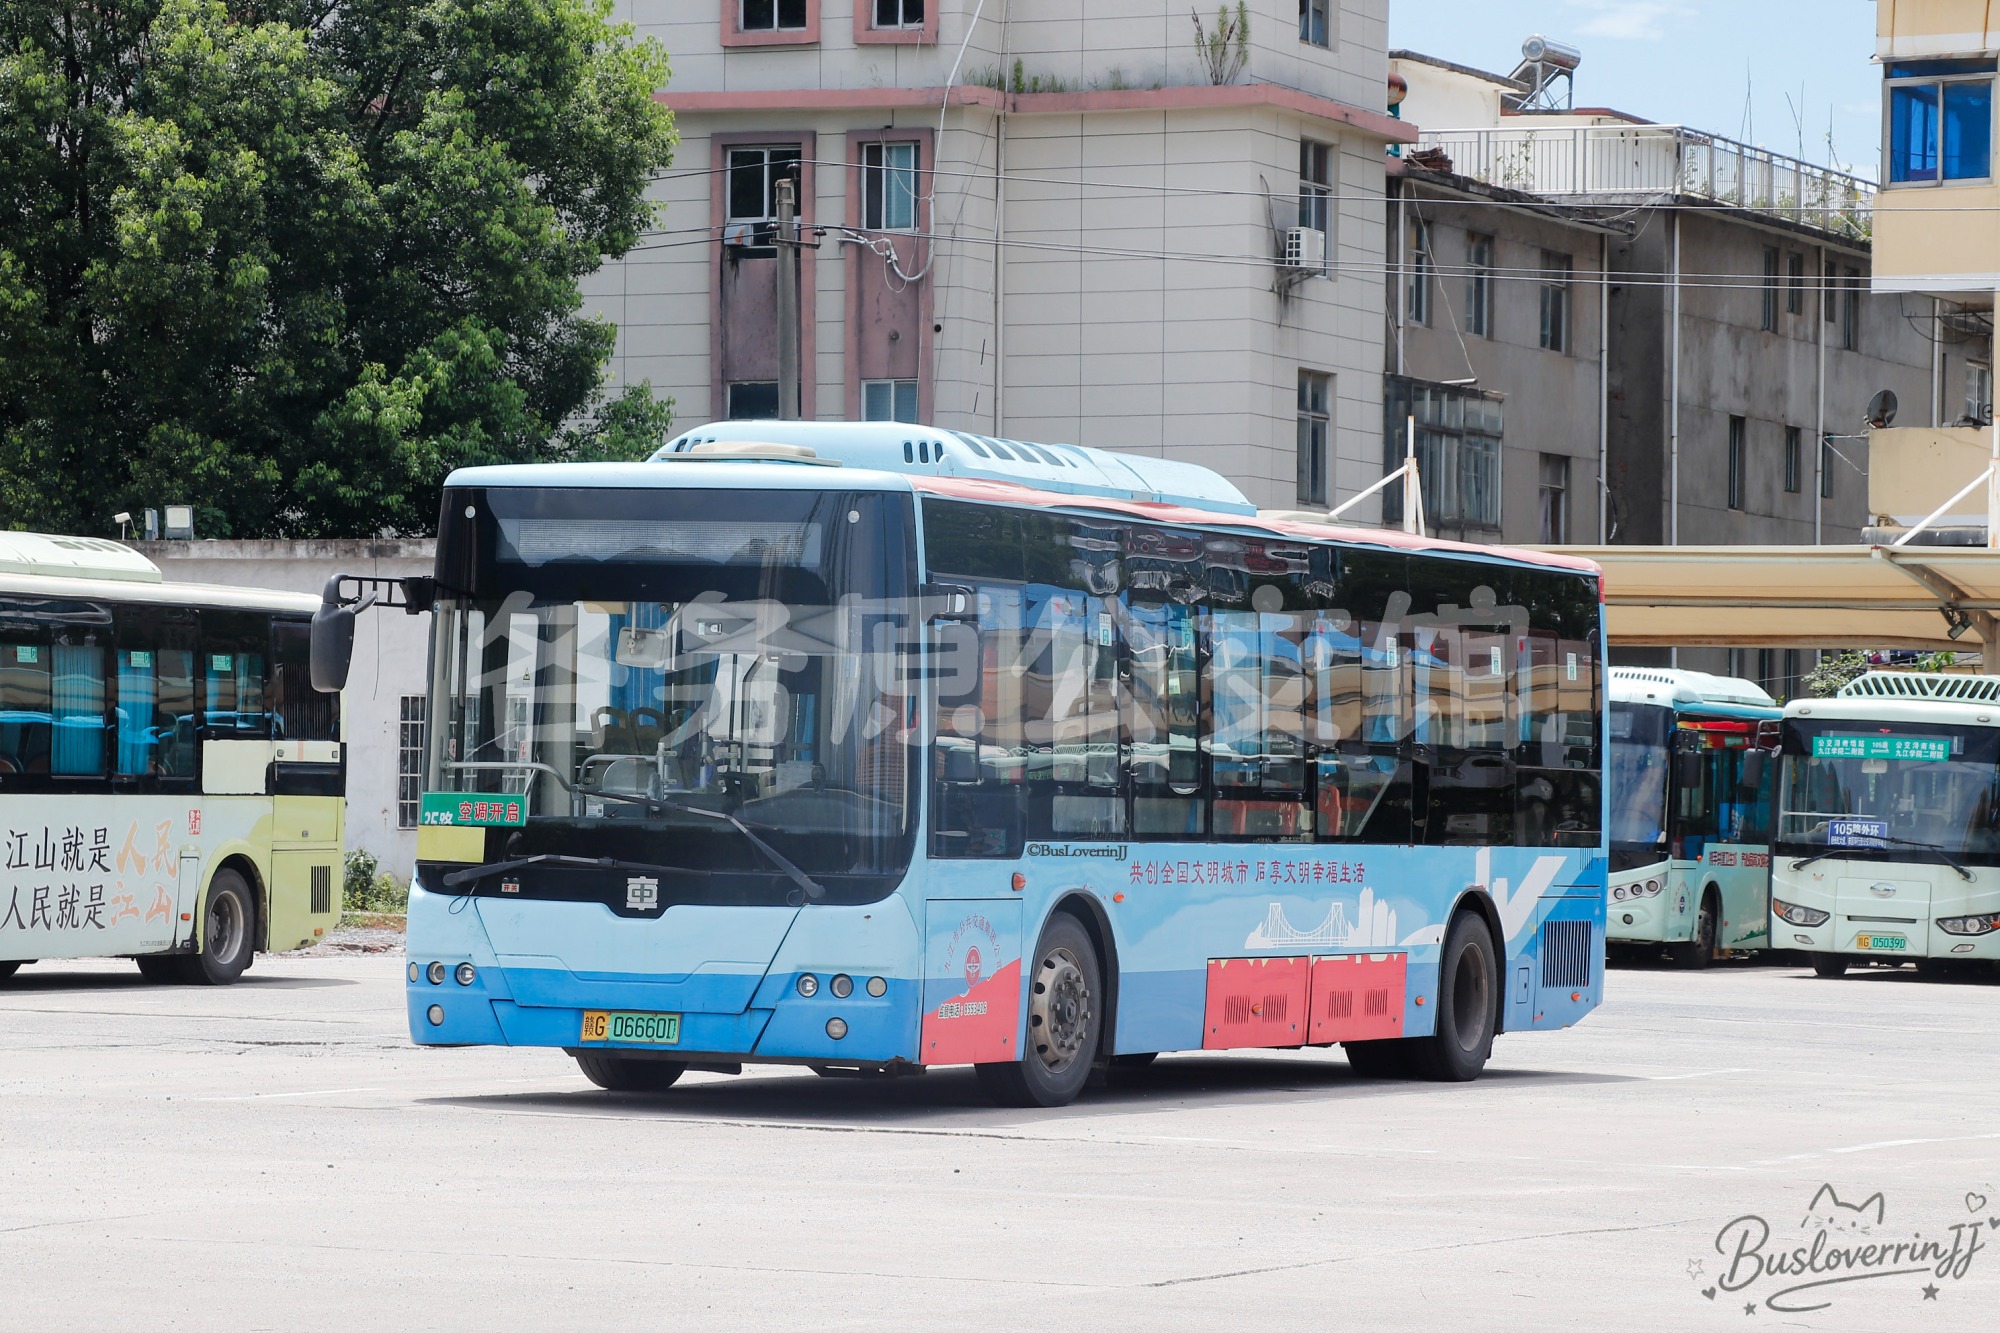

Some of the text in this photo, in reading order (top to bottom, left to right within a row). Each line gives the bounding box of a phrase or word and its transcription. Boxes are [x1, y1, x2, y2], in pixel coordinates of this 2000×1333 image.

[459, 801, 519, 822] 空调开启
[1834, 823, 1880, 836] 105路外环
[5, 819, 178, 878] 江山就是人民
[1130, 860, 1249, 885] 共创全国文明城市
[503, 884, 518, 892] 开关
[1, 881, 173, 930] 人民就是江山
